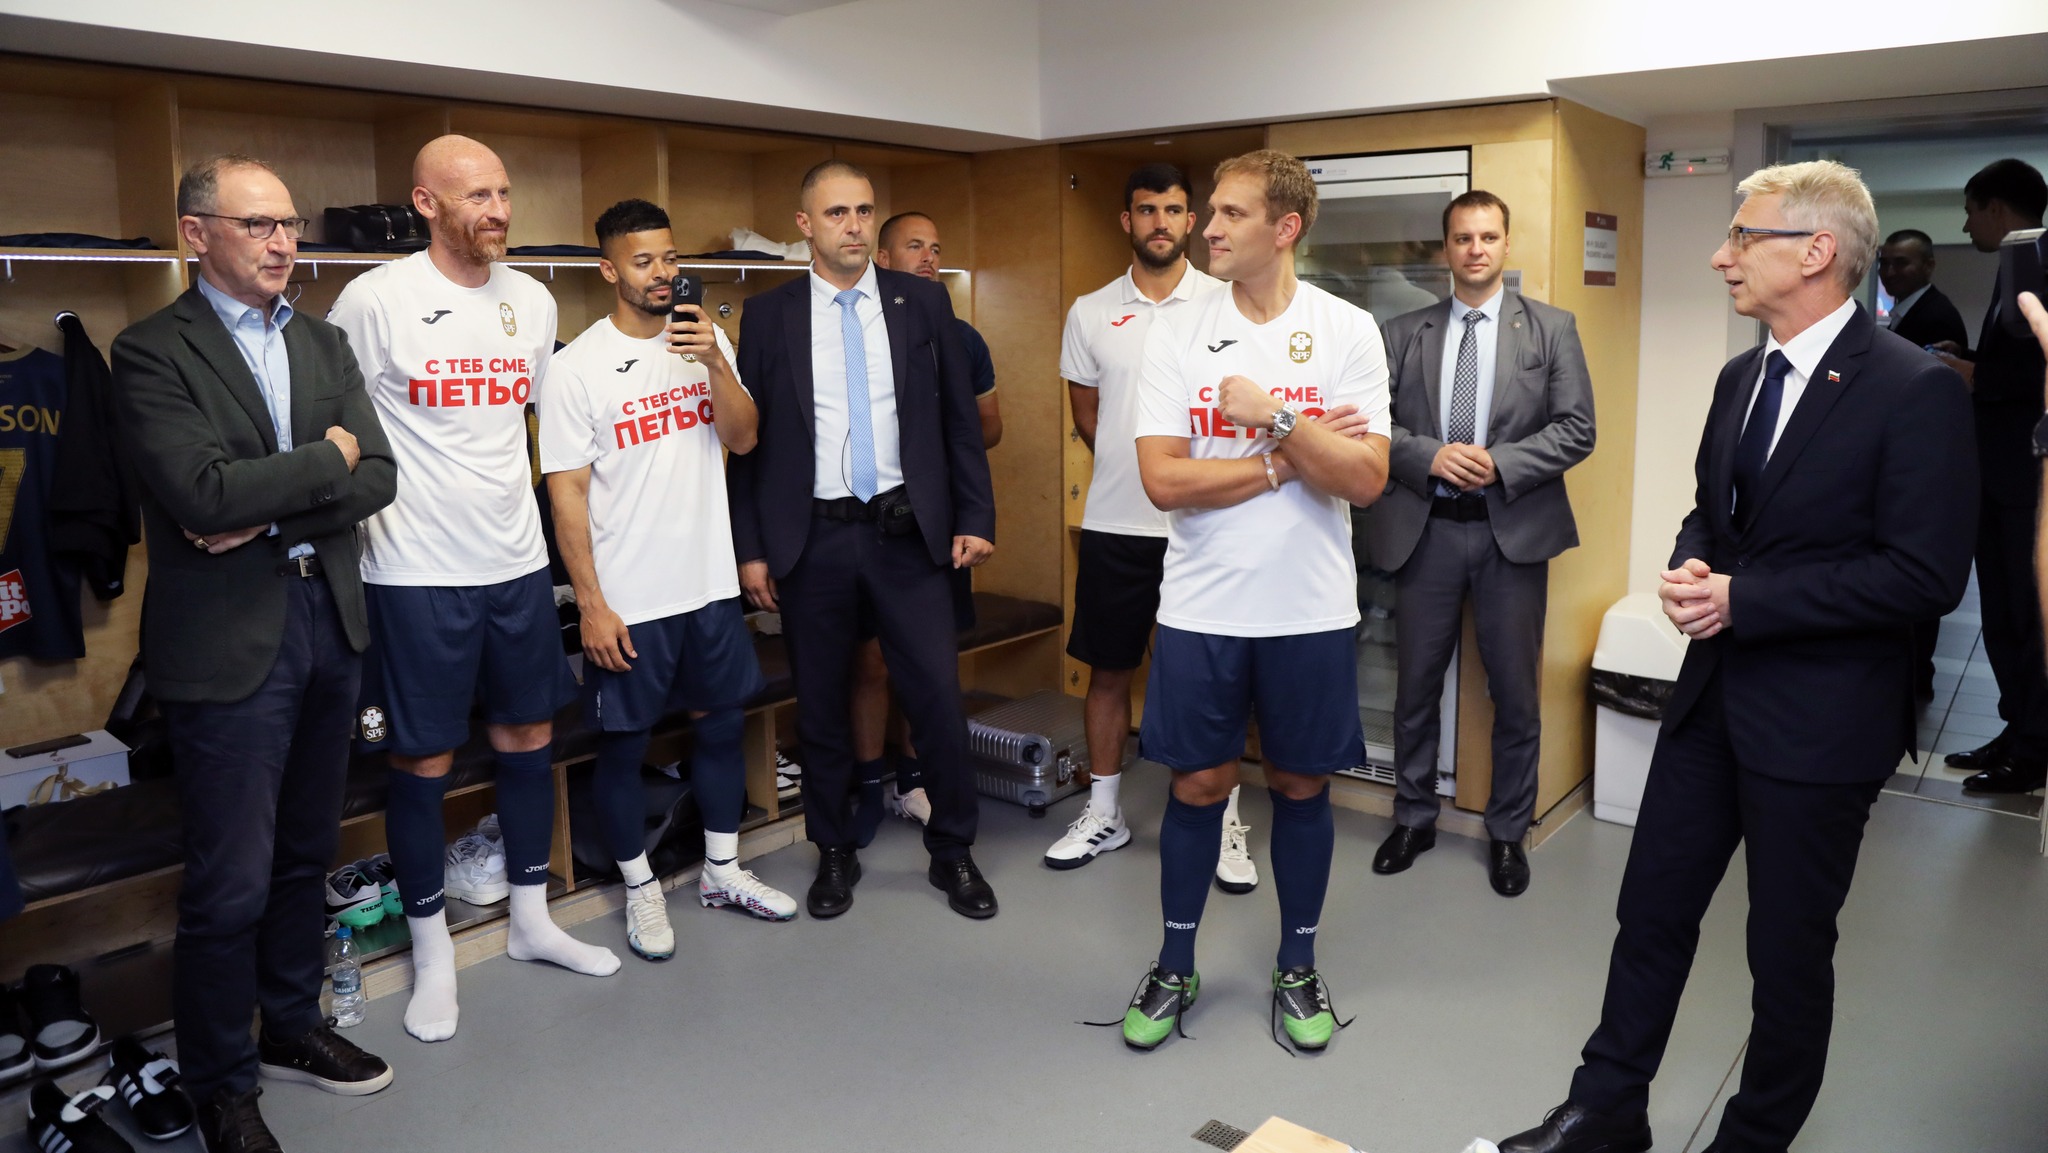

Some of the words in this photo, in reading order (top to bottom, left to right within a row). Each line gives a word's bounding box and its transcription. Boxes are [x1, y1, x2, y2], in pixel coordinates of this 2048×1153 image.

[1291, 351, 1311, 361] SPF
[425, 359, 440, 375] С
[446, 358, 484, 374] ТЕБ
[489, 358, 530, 376] СМЕ,
[622, 401, 636, 416] С
[638, 391, 669, 412] ТЕБ
[669, 381, 711, 402] СМЕ,
[1198, 386, 1213, 403] С
[366, 727, 386, 739] SPF
[1165, 920, 1196, 930] Joma
